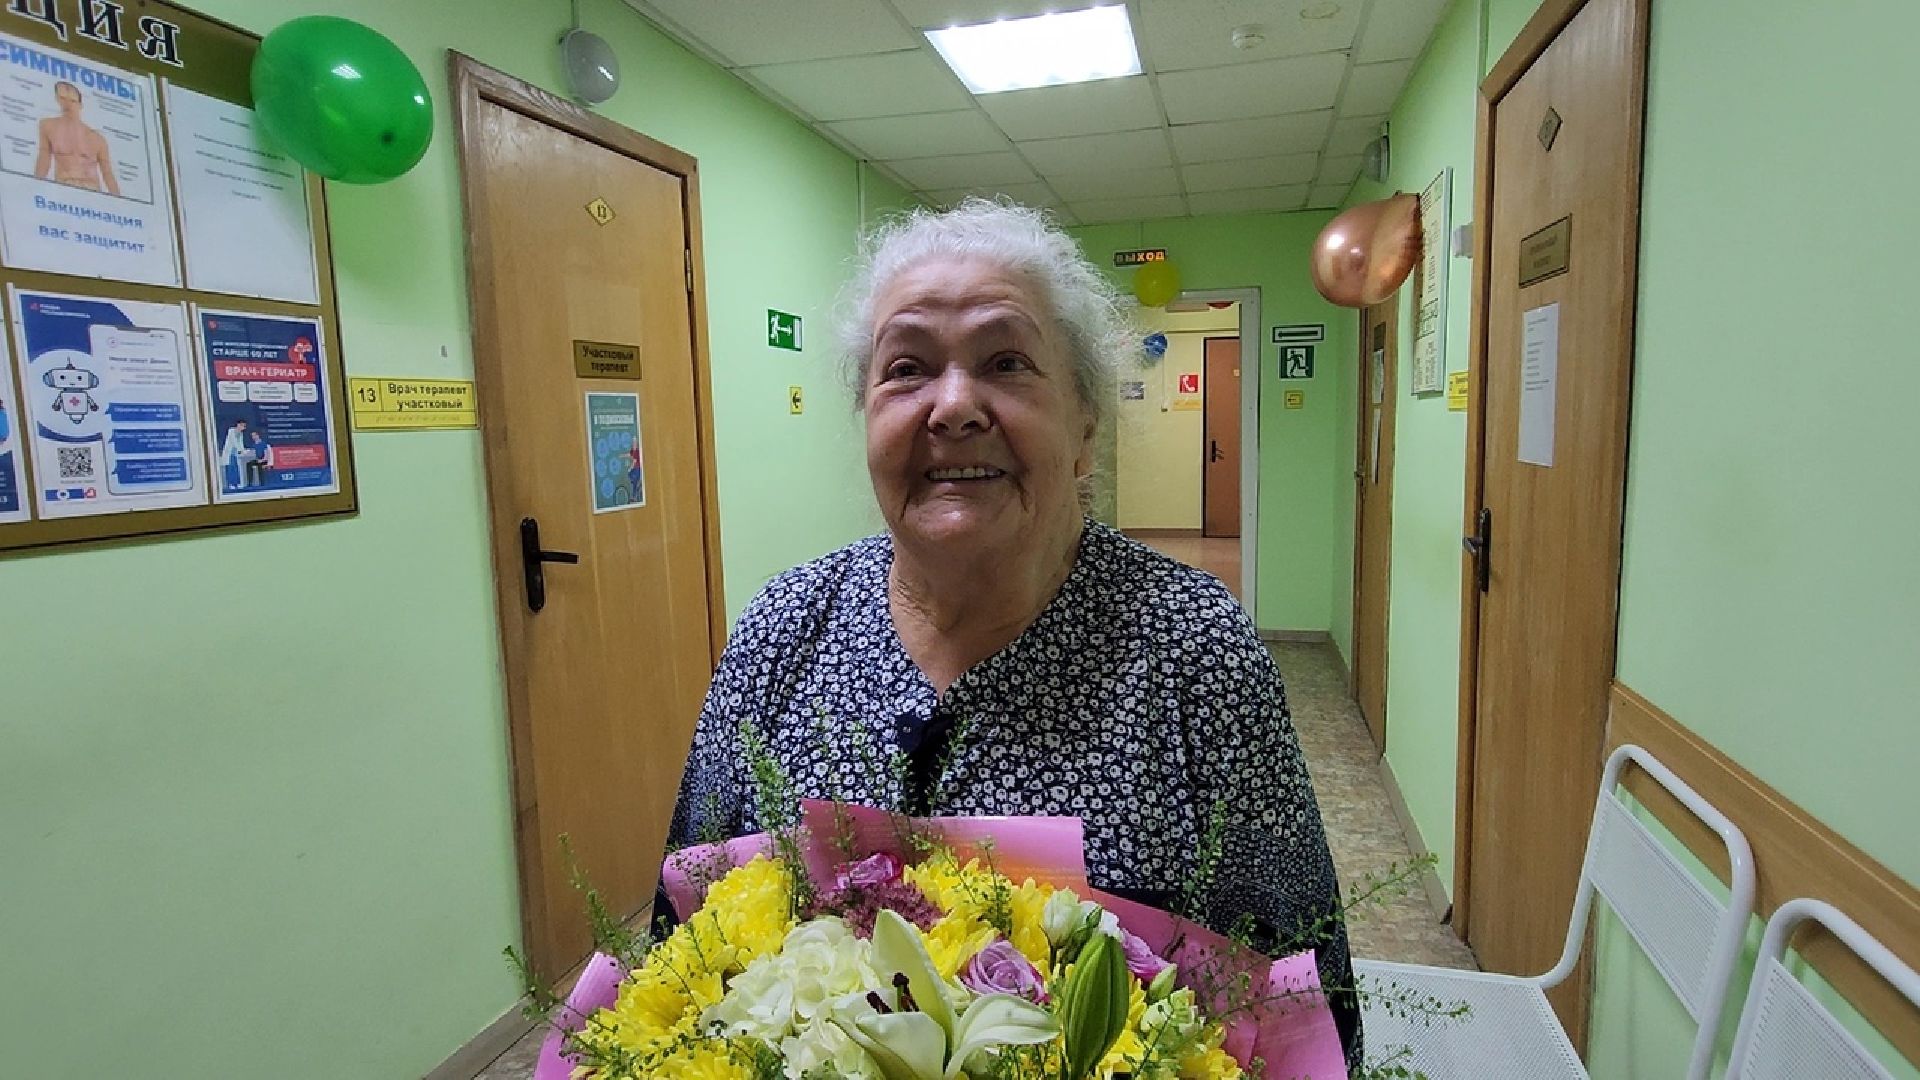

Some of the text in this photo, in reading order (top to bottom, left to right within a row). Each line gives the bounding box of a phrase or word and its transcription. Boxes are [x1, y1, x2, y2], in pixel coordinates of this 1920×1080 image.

[34, 195, 143, 229] Вакцинация
[39, 225, 145, 253] вас защитит
[1116, 251, 1165, 263] ВЫХОД
[224, 365, 308, 378] ВРАЧ-ГЕРИАТР
[358, 387, 376, 403] 13
[388, 383, 467, 396] Врач терапевт
[396, 399, 463, 412] участковый
